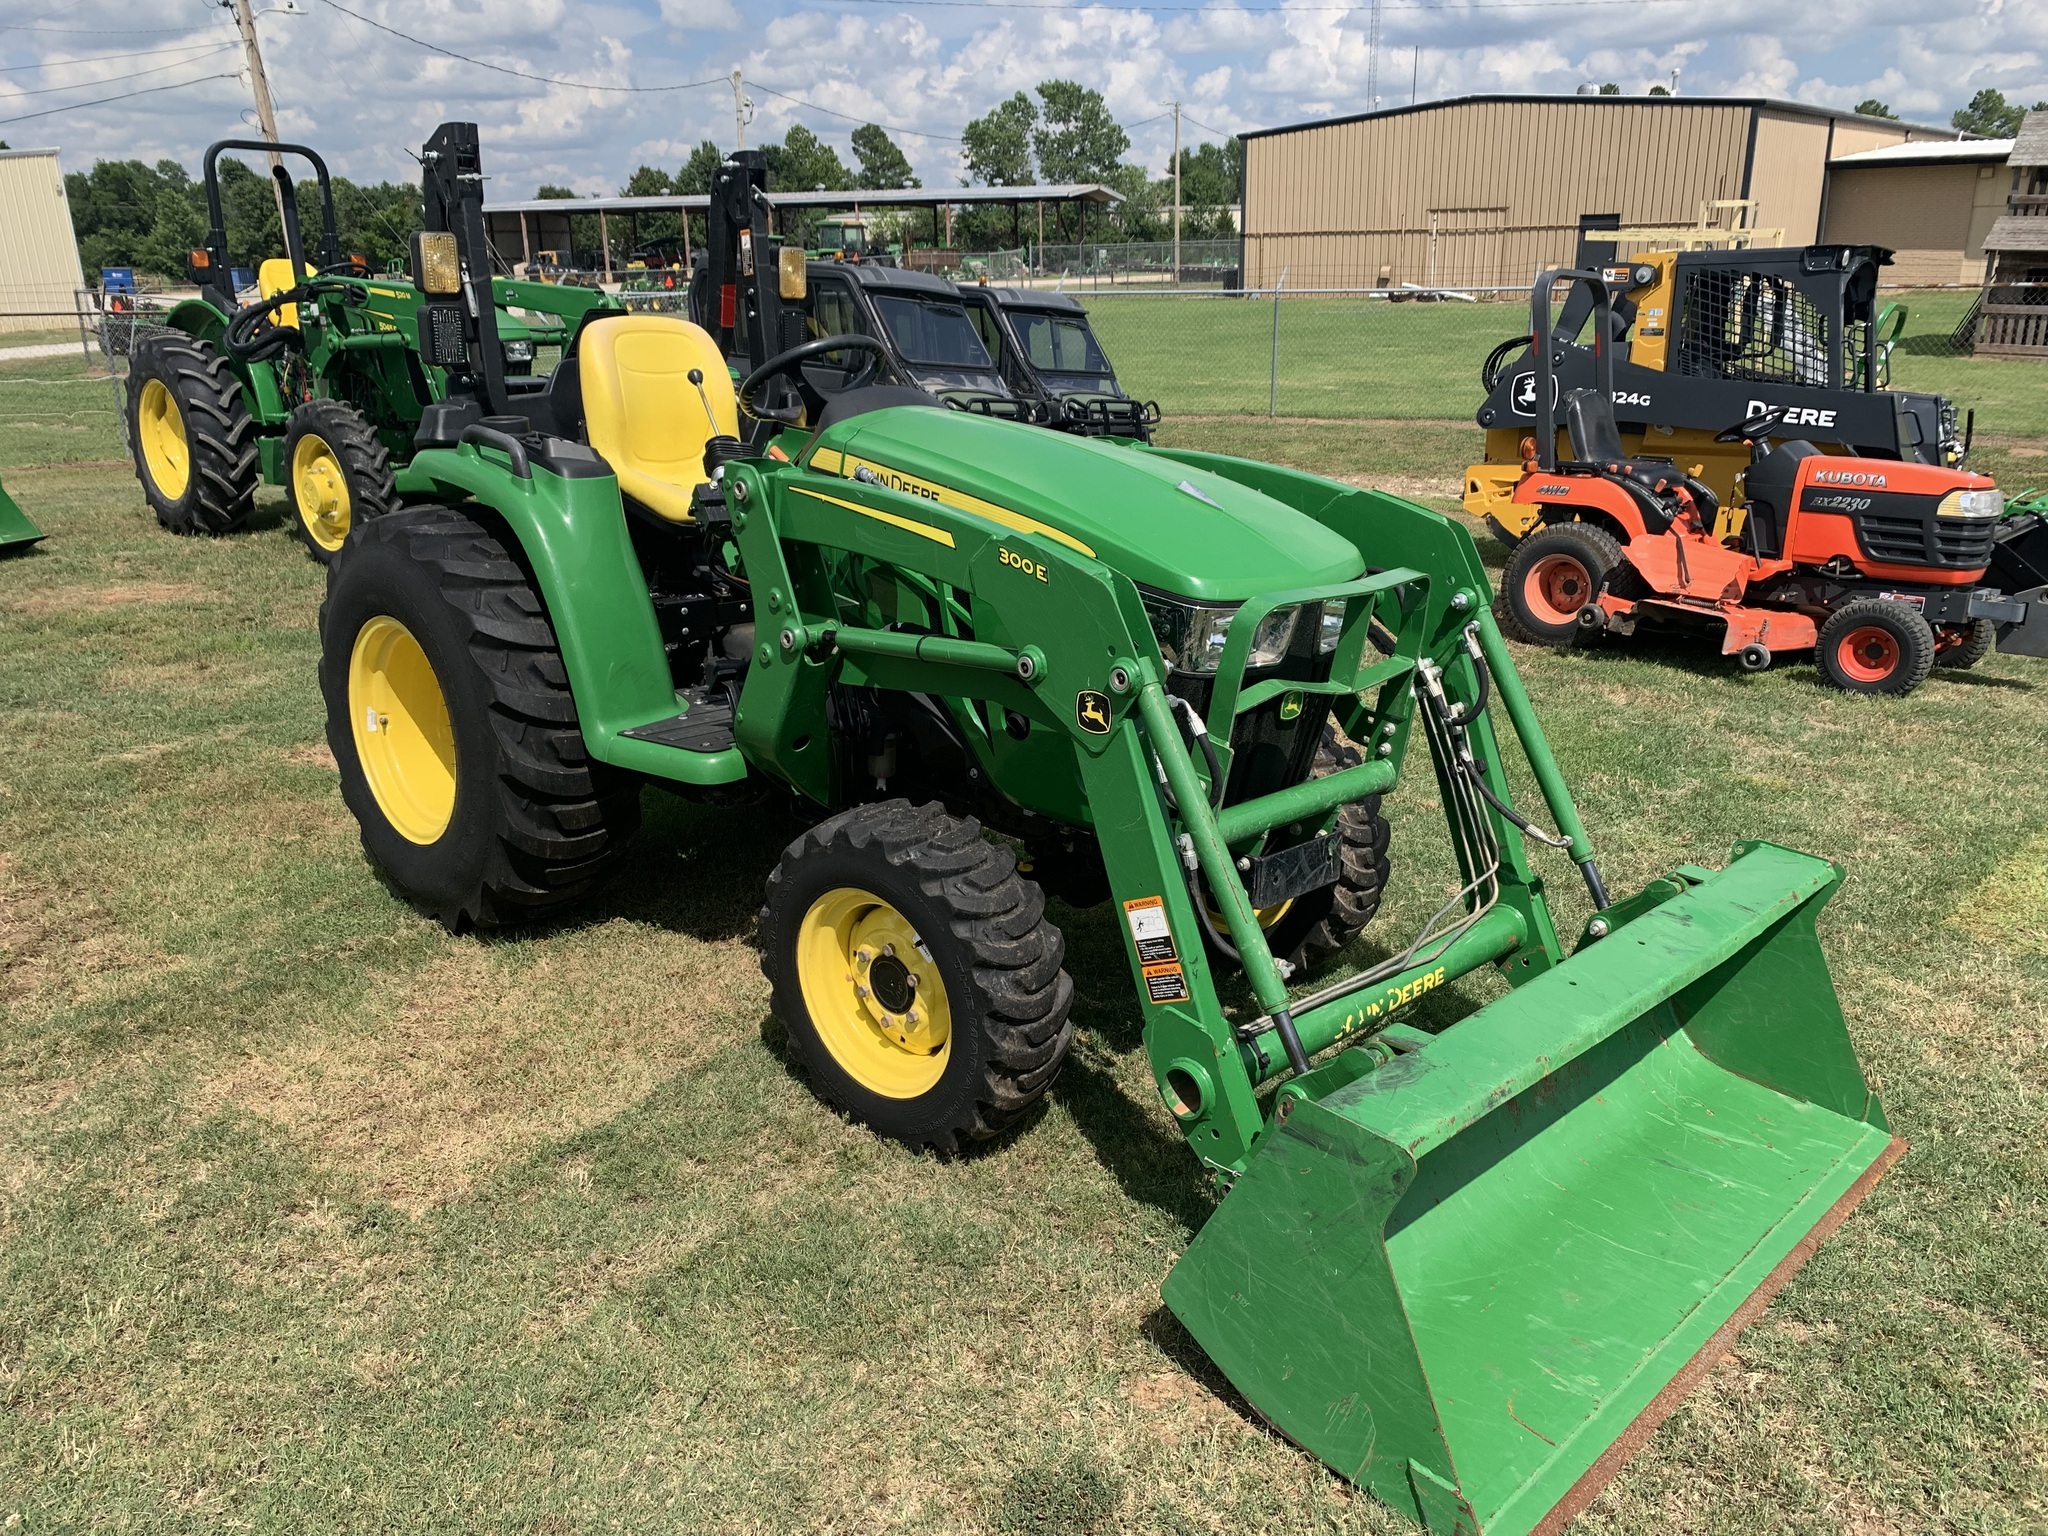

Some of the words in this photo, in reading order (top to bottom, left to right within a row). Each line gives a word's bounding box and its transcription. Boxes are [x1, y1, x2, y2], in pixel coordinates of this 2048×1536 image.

[1746, 400, 1837, 428] DEERE
[1814, 470, 1888, 488] KUBOTA
[999, 547, 1048, 583] 300E
[1134, 899, 1158, 907] WARNING
[1153, 966, 1178, 975] WARNING
[1387, 966, 1445, 1012] DEERE
